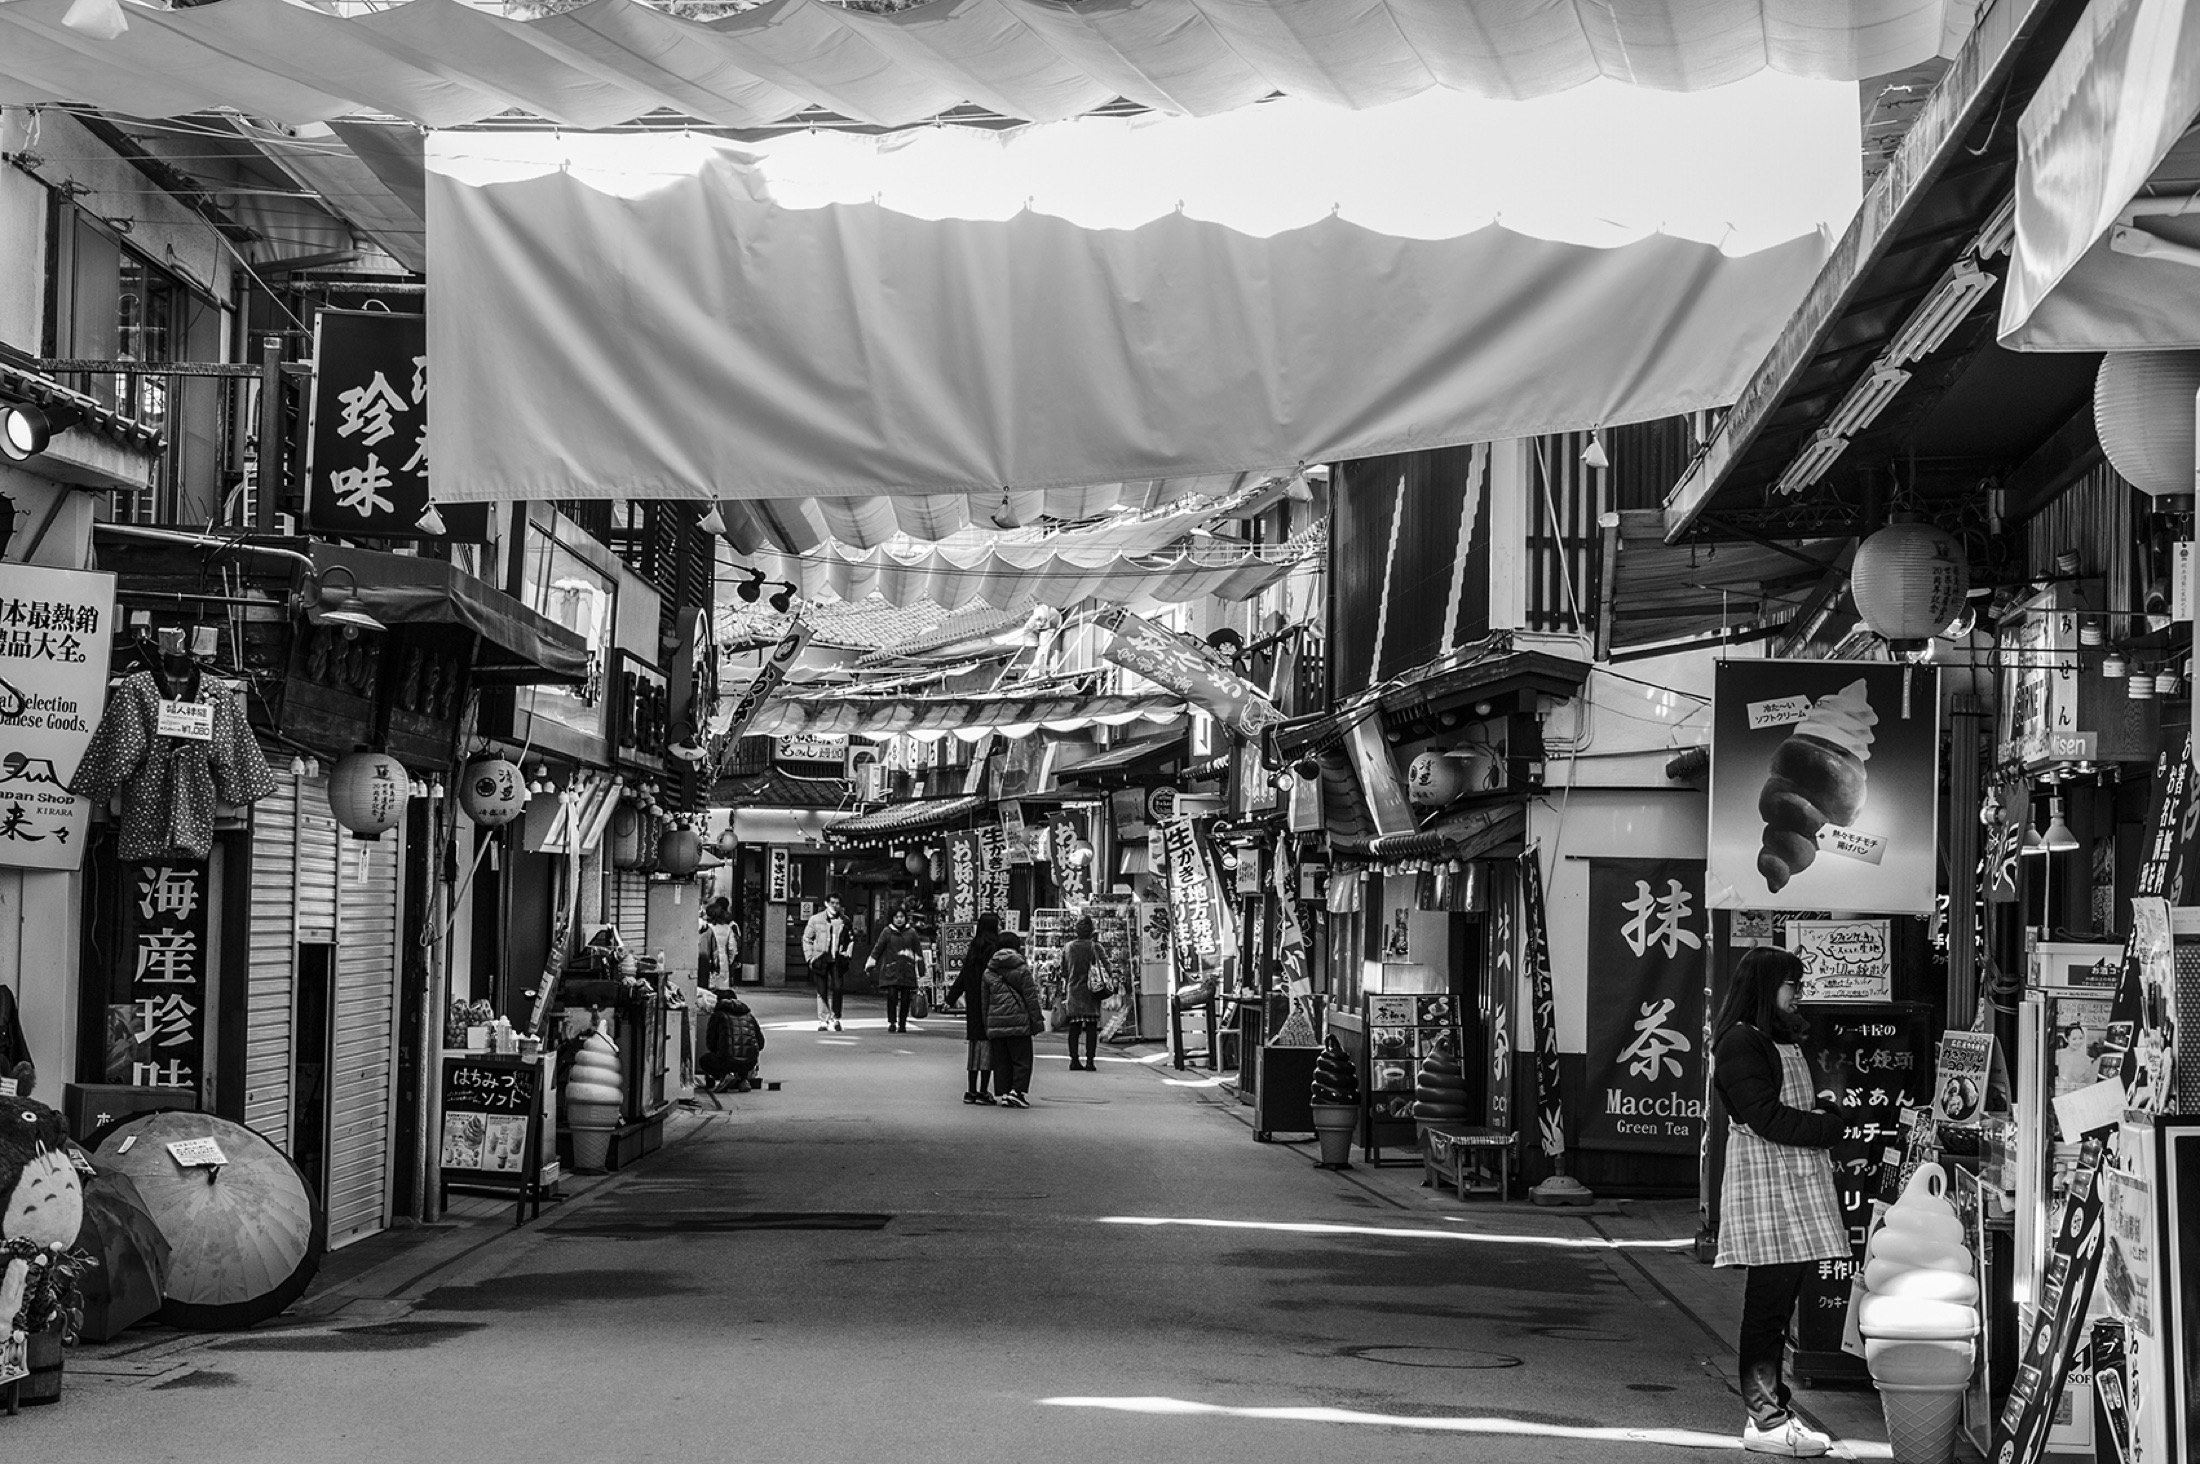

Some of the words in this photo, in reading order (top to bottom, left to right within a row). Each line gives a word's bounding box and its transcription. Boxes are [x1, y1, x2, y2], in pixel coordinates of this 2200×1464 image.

[329, 371, 409, 517] 珍味
[0, 597, 99, 634] 本最熱銷
[2058, 615, 2073, 726] みせん
[47, 713, 89, 733] Goods.
[1755, 710, 1807, 724] ソフトクリーム
[37, 791, 75, 805] Shop
[36, 807, 73, 817] KIRARA
[1167, 827, 1194, 884] 生かき
[1187, 883, 1216, 954] 地方発送
[1616, 878, 1701, 1081] 抹茶
[1833, 1024, 1896, 1036] ケーキ屋の
[454, 1068, 515, 1088] はちみつ
[481, 1088, 521, 1108] ソフト
[1605, 1088, 1701, 1118] Maccha
[1816, 1087, 1914, 1107] つぶあん
[1616, 1119, 1658, 1135] Green
[1665, 1121, 1689, 1136] Tea
[1818, 1260, 1861, 1280] 手作り
[1818, 1295, 1848, 1308] クッキー
